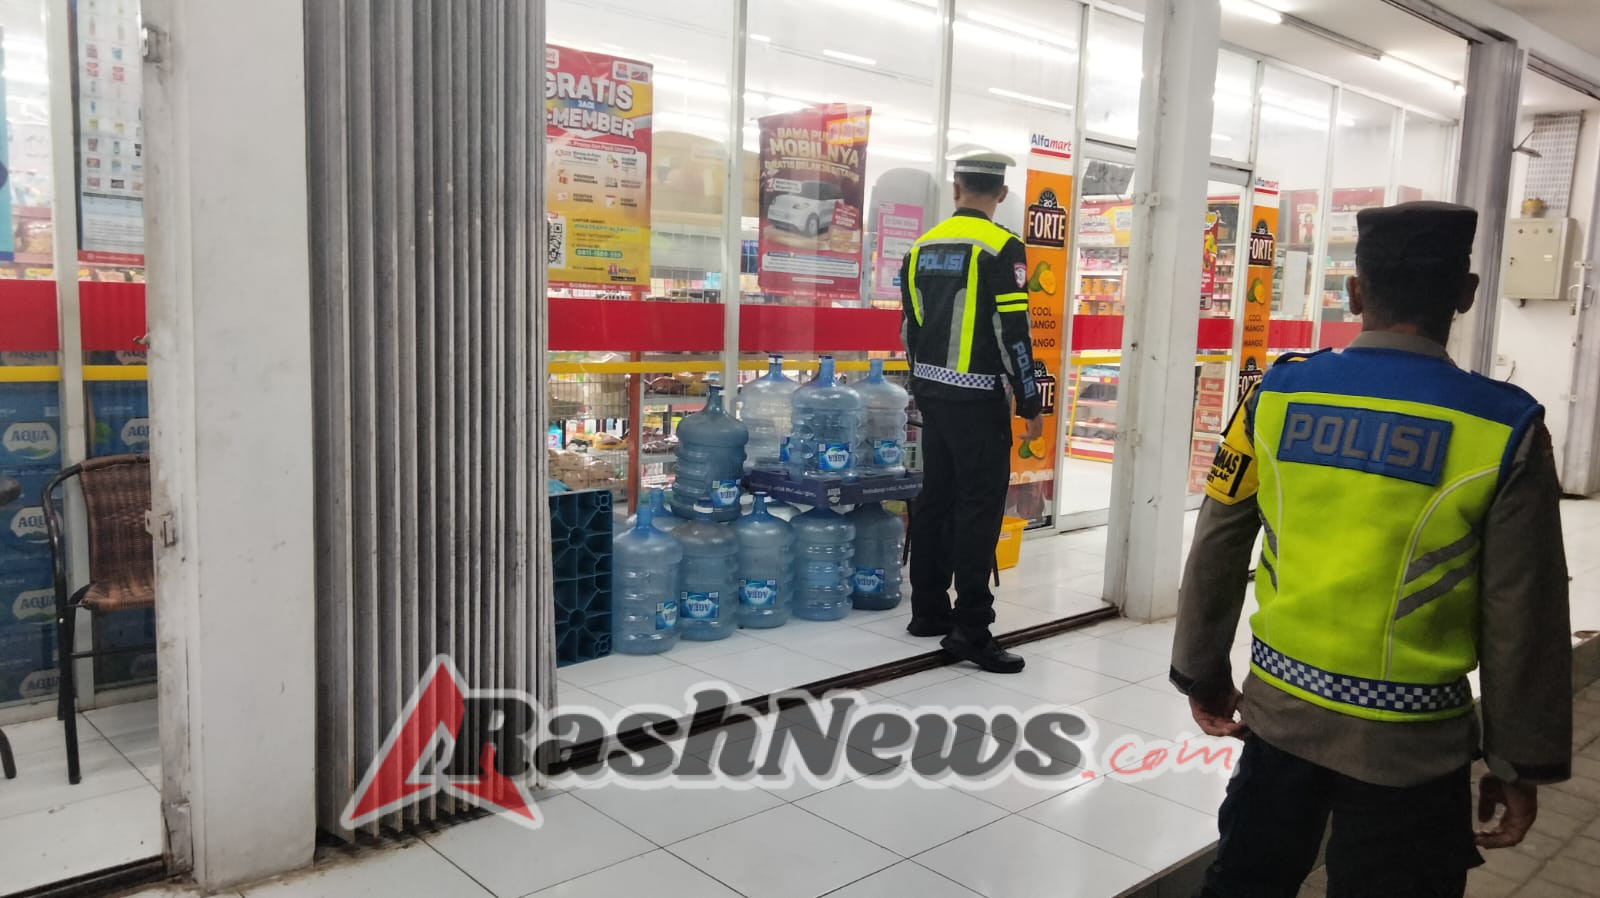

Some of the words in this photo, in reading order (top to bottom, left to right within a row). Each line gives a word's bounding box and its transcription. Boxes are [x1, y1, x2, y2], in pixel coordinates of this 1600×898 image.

[1030, 133, 1072, 151] Alfamart
[1028, 211, 1066, 240] FORTE
[918, 253, 965, 271] POLISI
[1032, 306, 1052, 316] COOL
[1032, 338, 1056, 348] ANGO
[1012, 340, 1037, 399] POLISI
[11, 430, 50, 442] AQUA
[1283, 413, 1442, 472] POLISI
[17, 516, 47, 529] AQU
